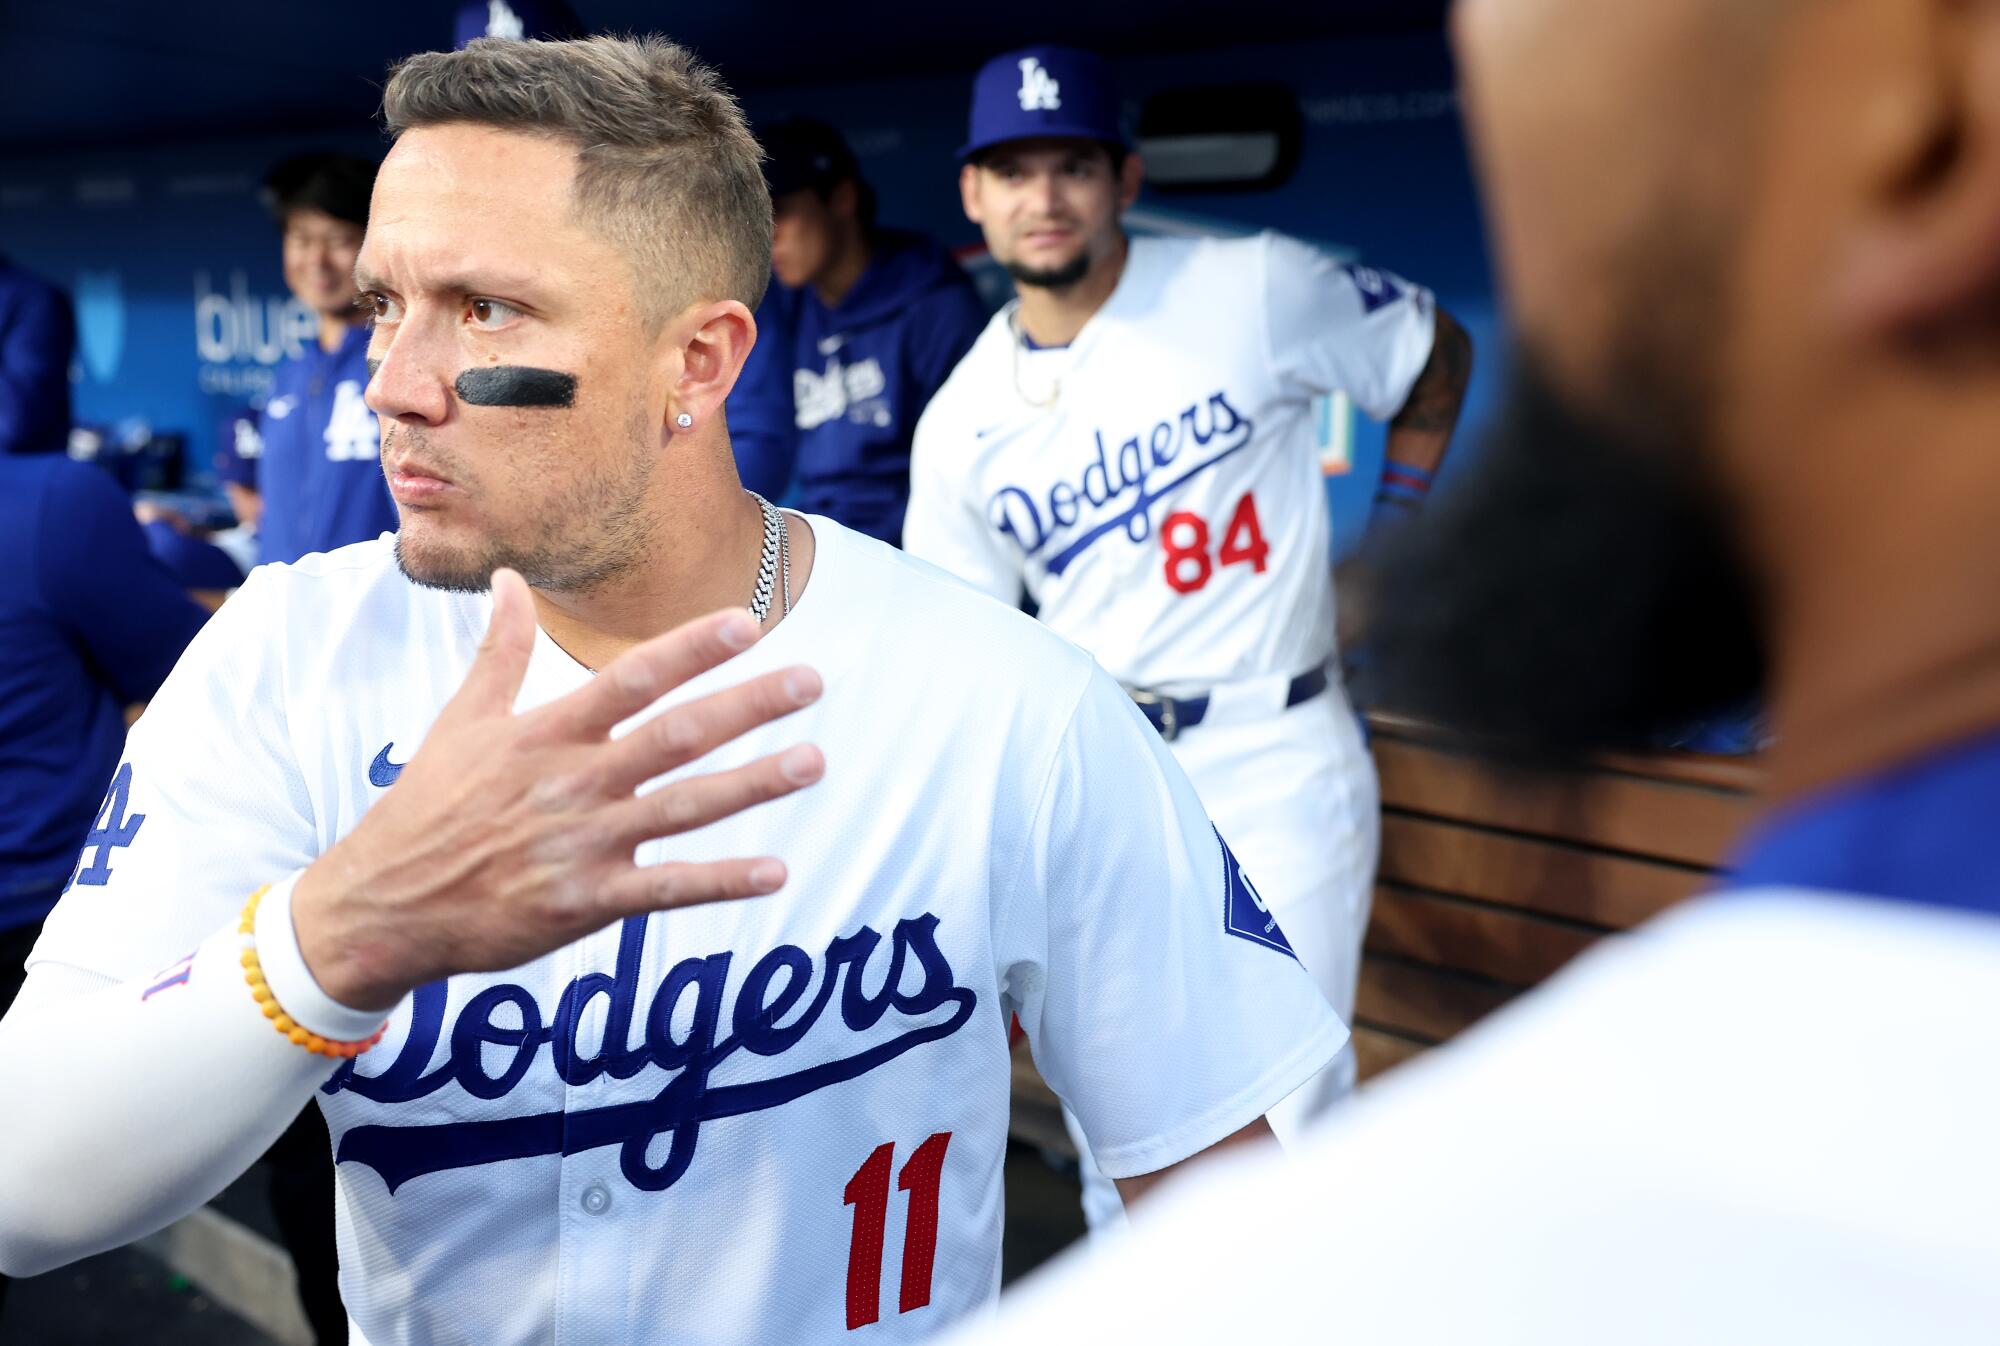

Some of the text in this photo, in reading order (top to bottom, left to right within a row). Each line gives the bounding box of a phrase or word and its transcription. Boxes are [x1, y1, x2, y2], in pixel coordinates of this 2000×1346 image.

[1017, 56, 1062, 112] LA
[195, 270, 320, 364] blue
[987, 392, 1252, 558] Dodgers
[1160, 491, 1269, 596] 84
[62, 762, 146, 894] A
[843, 1132, 952, 1331] 11
